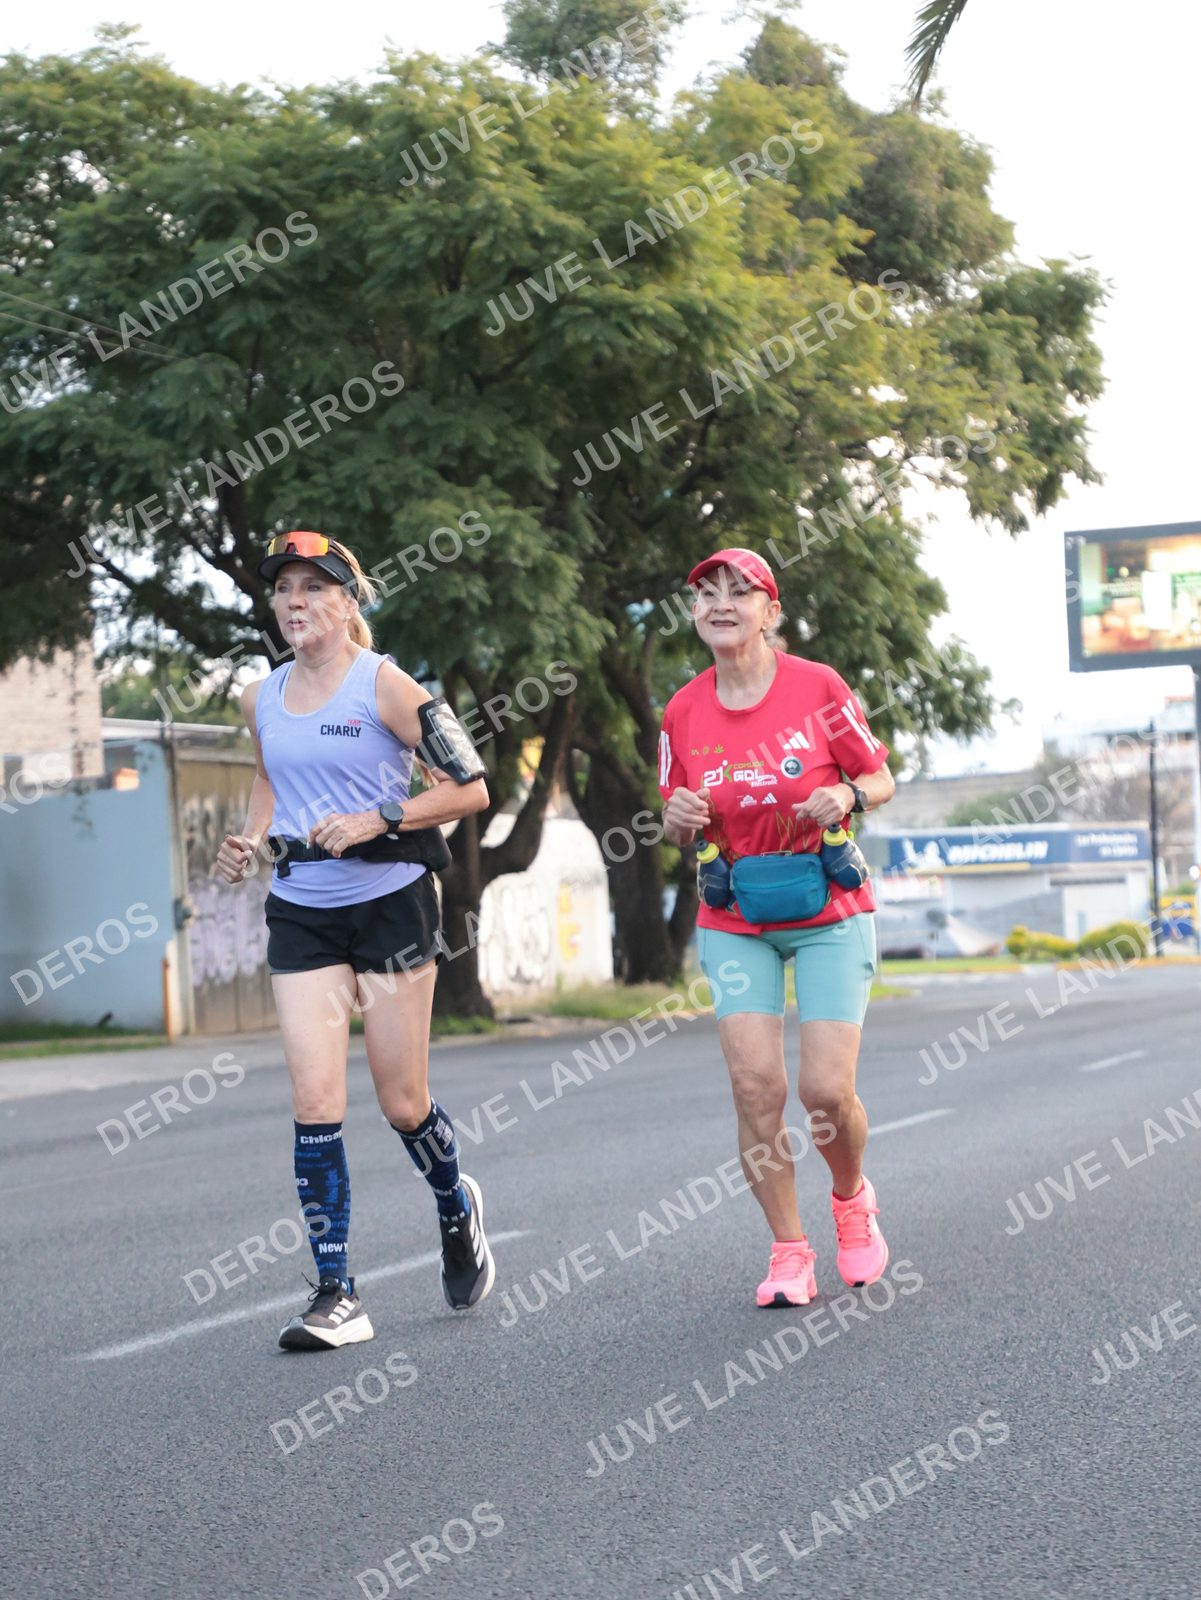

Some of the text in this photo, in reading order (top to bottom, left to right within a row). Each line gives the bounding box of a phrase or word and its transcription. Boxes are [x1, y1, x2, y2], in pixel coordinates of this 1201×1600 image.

[320, 724, 362, 738] CHARLY
[733, 769, 760, 782] GDL
[318, 1242, 343, 1254] New
